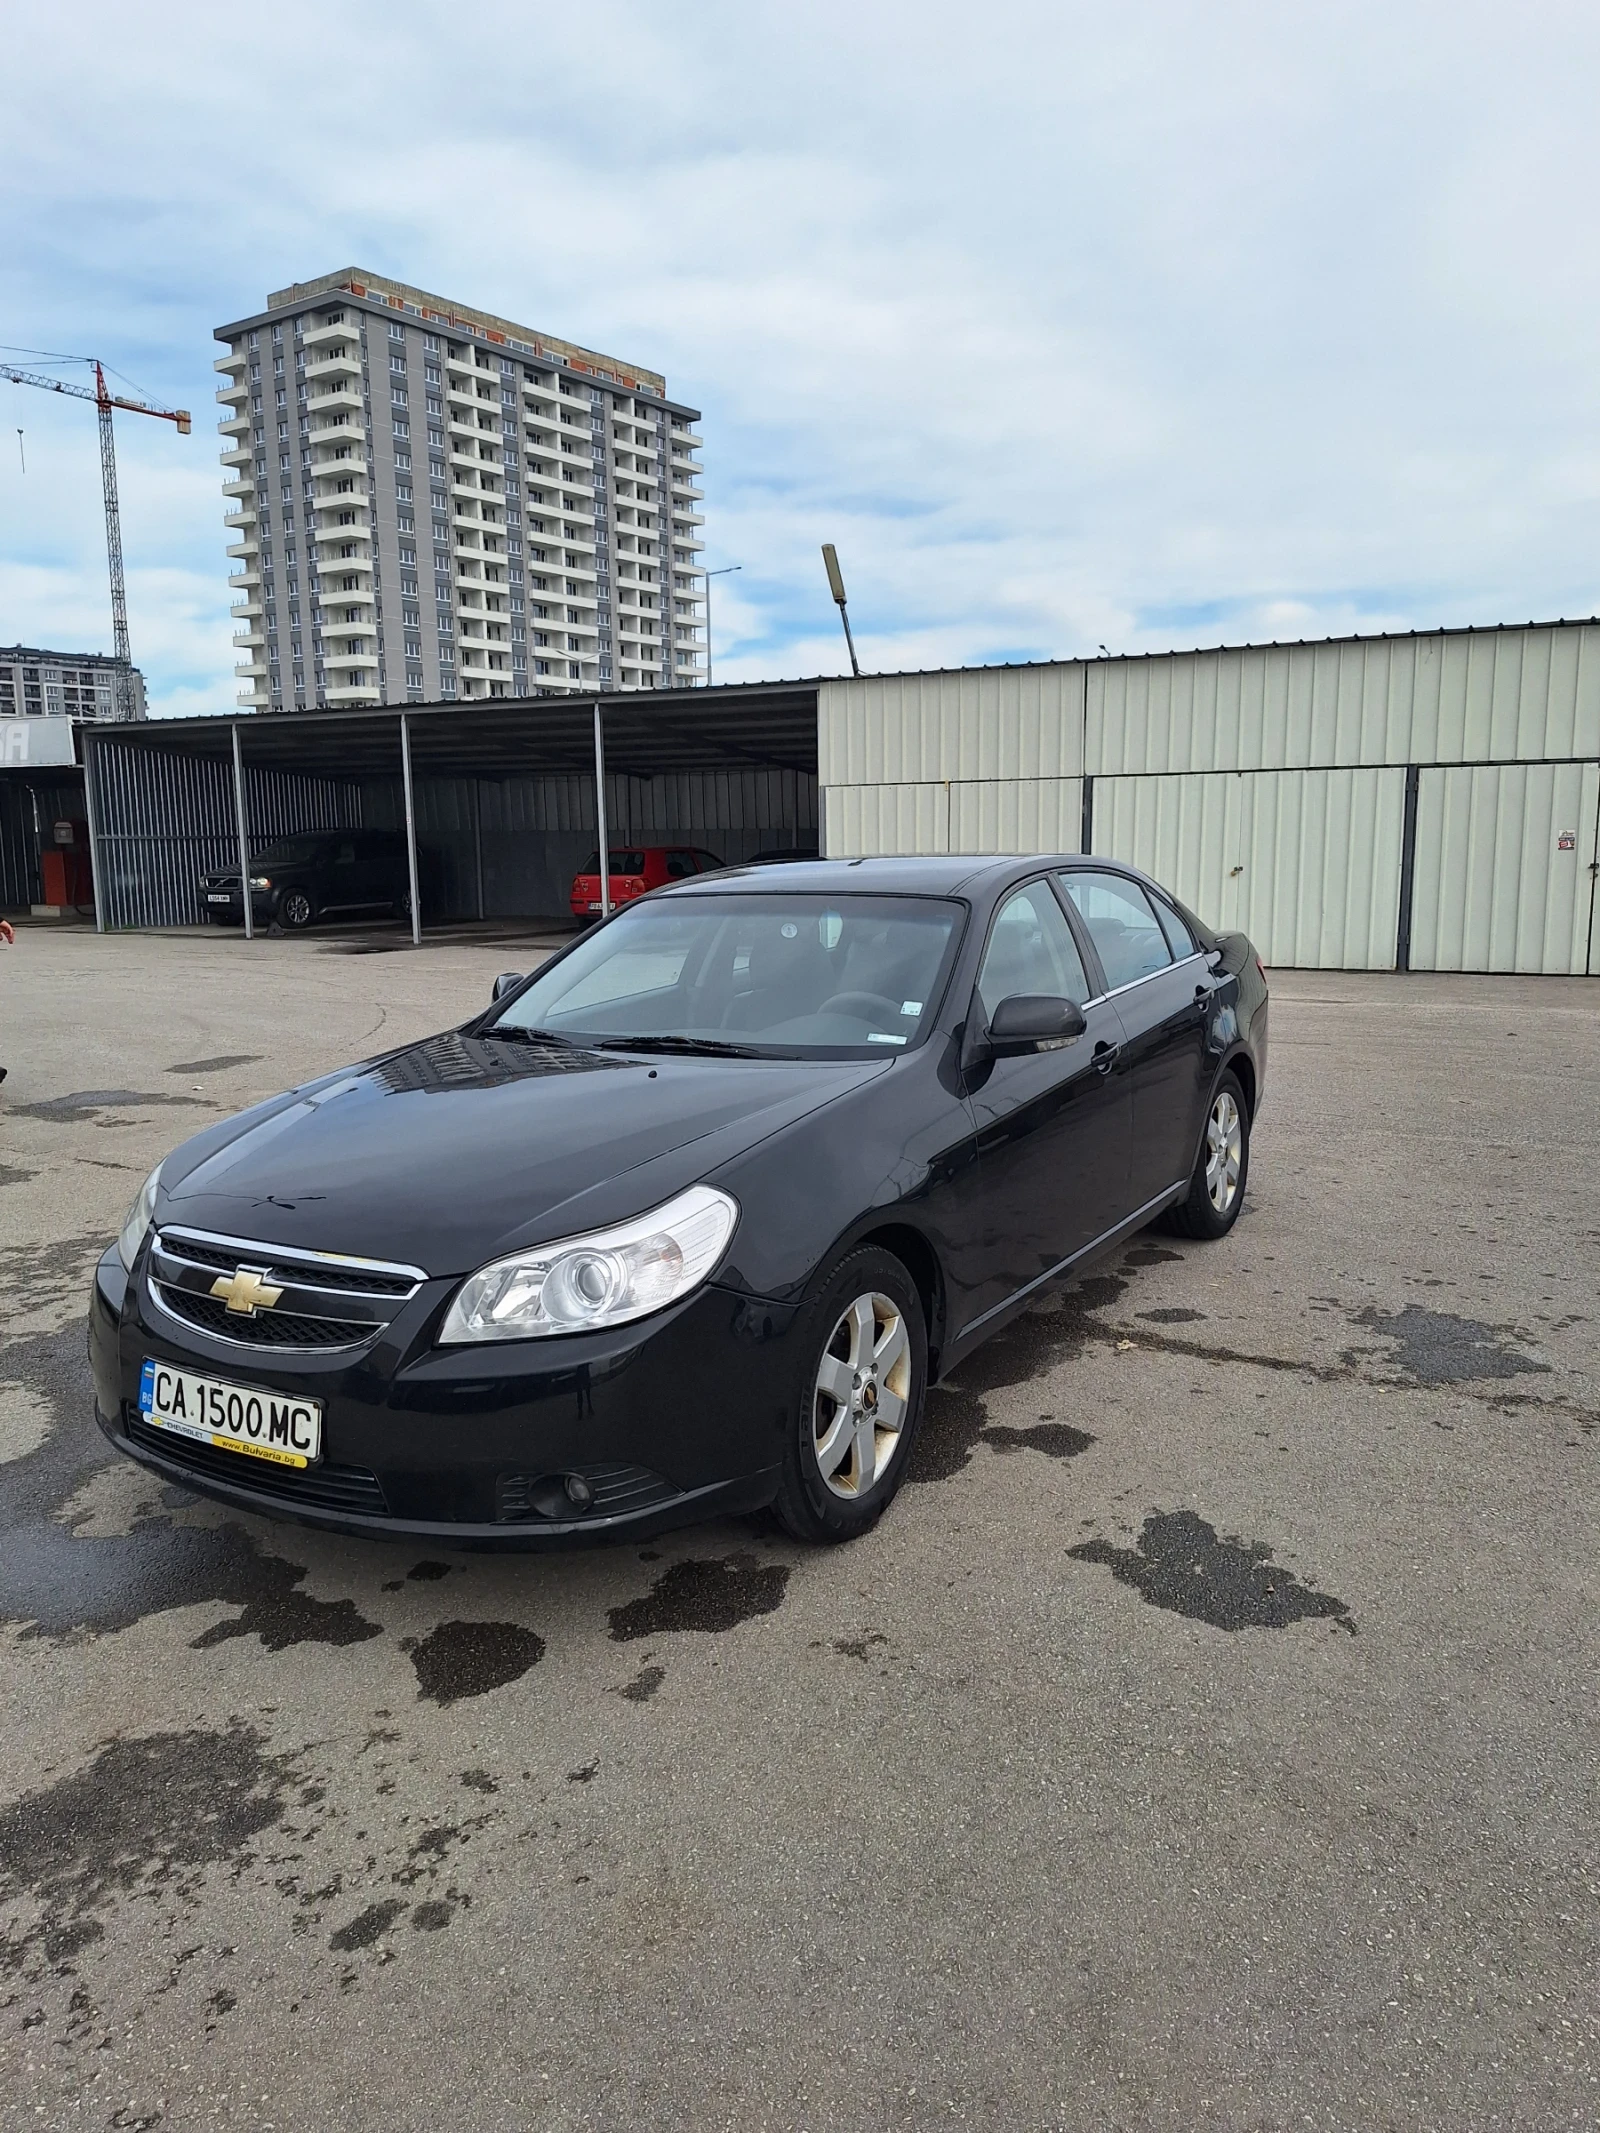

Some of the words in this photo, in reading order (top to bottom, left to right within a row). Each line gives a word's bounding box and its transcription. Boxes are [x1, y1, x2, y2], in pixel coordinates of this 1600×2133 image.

[142, 1391, 152, 1405] BG
[156, 1371, 187, 1419] CA
[197, 1384, 263, 1438] 1500
[269, 1401, 312, 1450] MC
[166, 1422, 203, 1439] CHEVROLET
[222, 1440, 296, 1466] www.Bulvaria.bg
